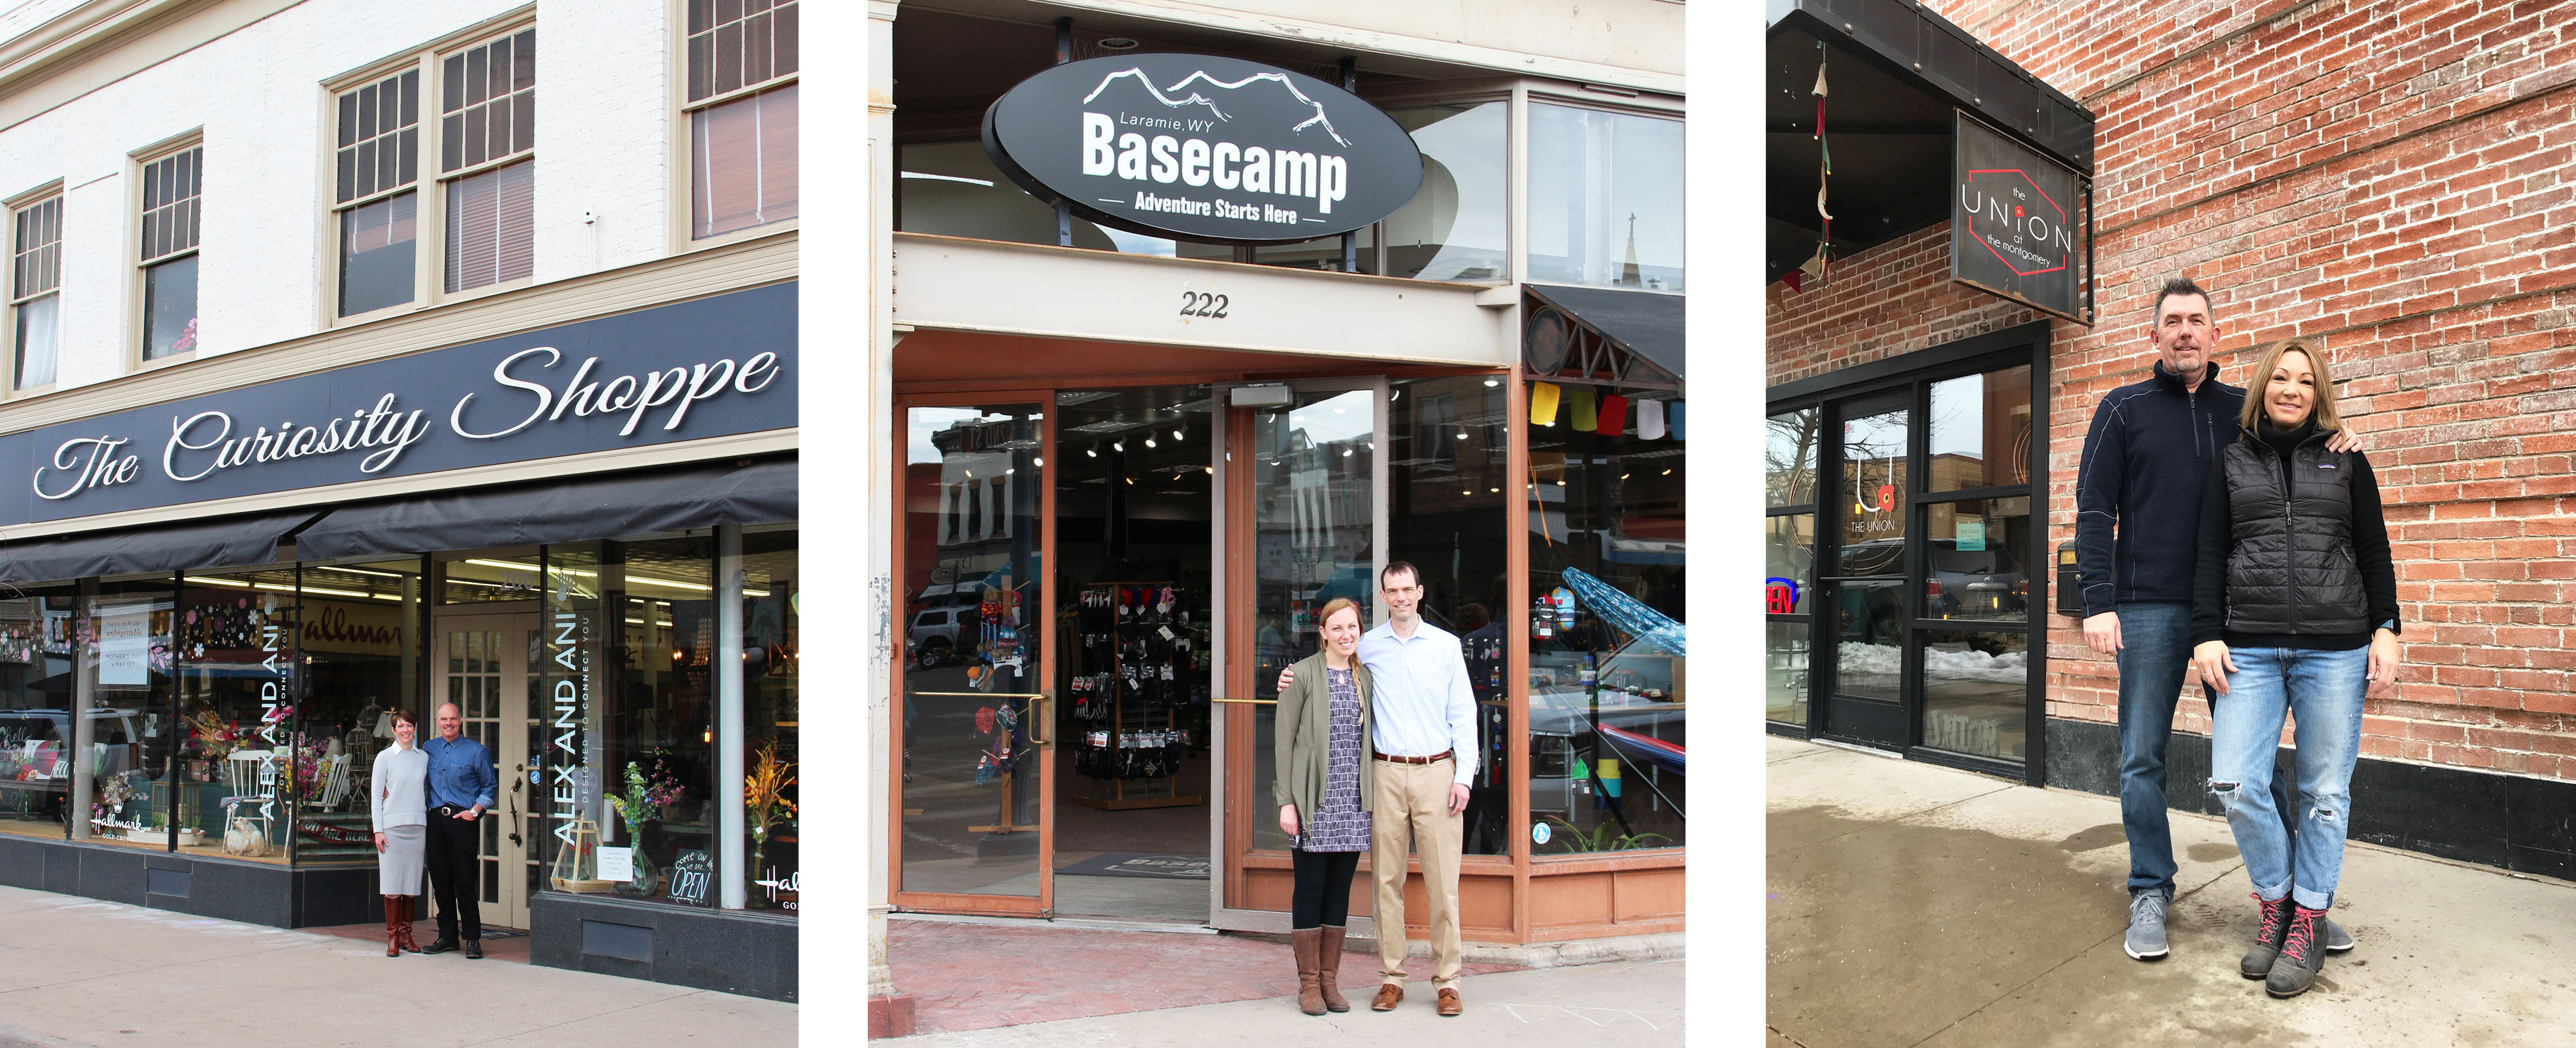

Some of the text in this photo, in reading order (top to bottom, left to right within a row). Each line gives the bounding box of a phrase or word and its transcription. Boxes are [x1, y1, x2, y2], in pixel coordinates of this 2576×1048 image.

[1082, 112, 1347, 214] Basecamp
[2012, 186, 2026, 201] the
[1134, 191, 1297, 224] Adventure Starts Here
[1987, 233, 2051, 268] the montgomery
[2013, 235, 2023, 244] at
[1180, 291, 1229, 319] 222
[33, 346, 780, 500] The Curiosity Shoppe
[1851, 519, 1895, 533] THE UNION
[500, 570, 534, 591] 206
[107, 629, 142, 637] unforgettable
[261, 681, 278, 745] AND
[280, 713, 286, 725] TO
[555, 680, 576, 755] AND
[582, 717, 589, 732] TO
[259, 753, 276, 822] ALEX
[554, 763, 576, 846] ALEX
[90, 809, 146, 834] Hallmark
[320, 827, 341, 840] ARE
[345, 831, 370, 842] HERE
[698, 853, 708, 862] ON
[671, 866, 711, 900] OPEN
[783, 901, 799, 910] GO
